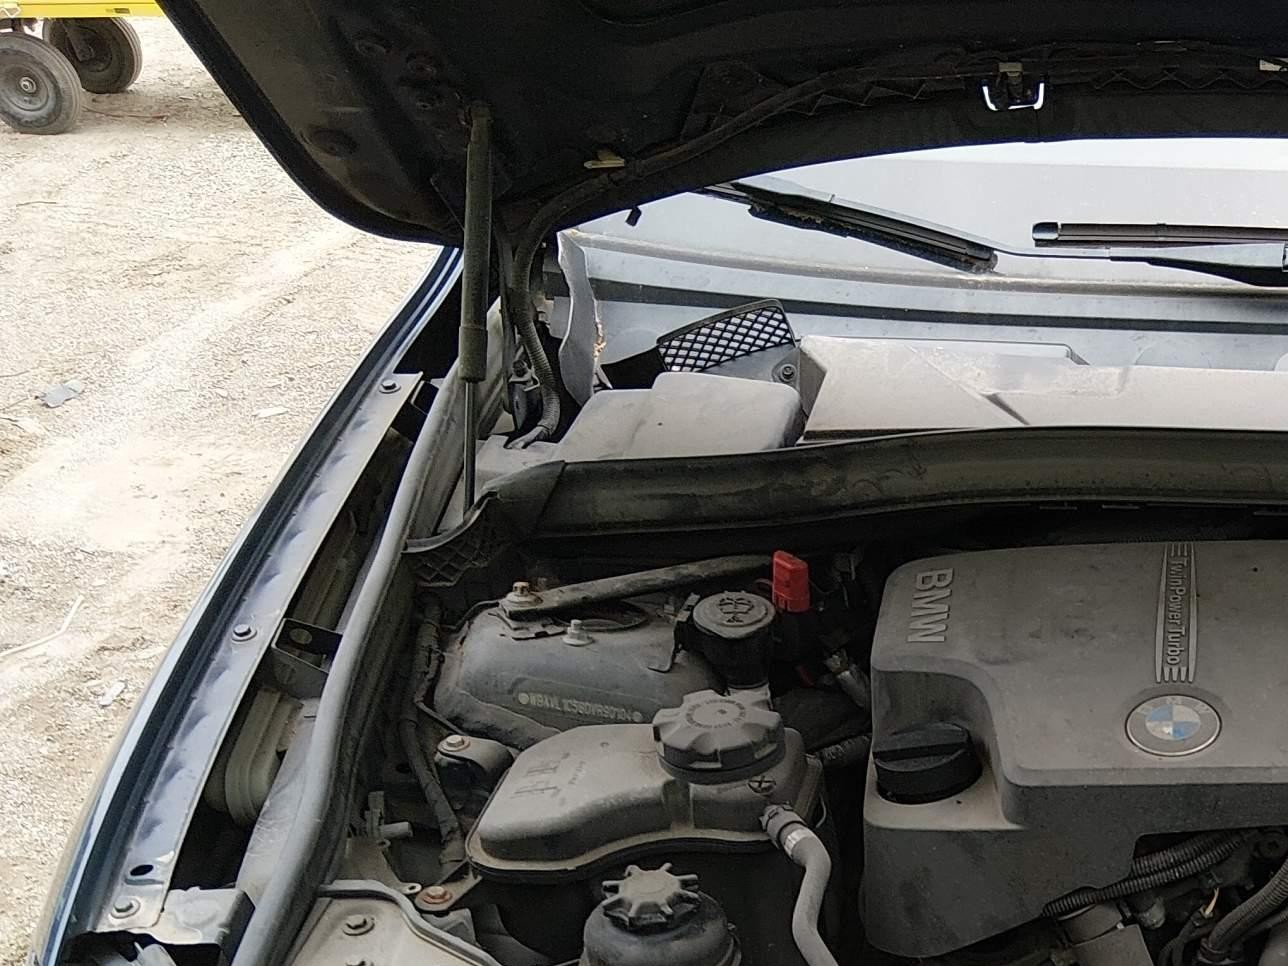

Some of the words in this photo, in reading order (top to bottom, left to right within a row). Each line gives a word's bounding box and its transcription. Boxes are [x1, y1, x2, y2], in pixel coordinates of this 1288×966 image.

[907, 568, 953, 642] BMW
[1168, 557, 1188, 625] TwinPower
[1166, 626, 1186, 665] Turbo
